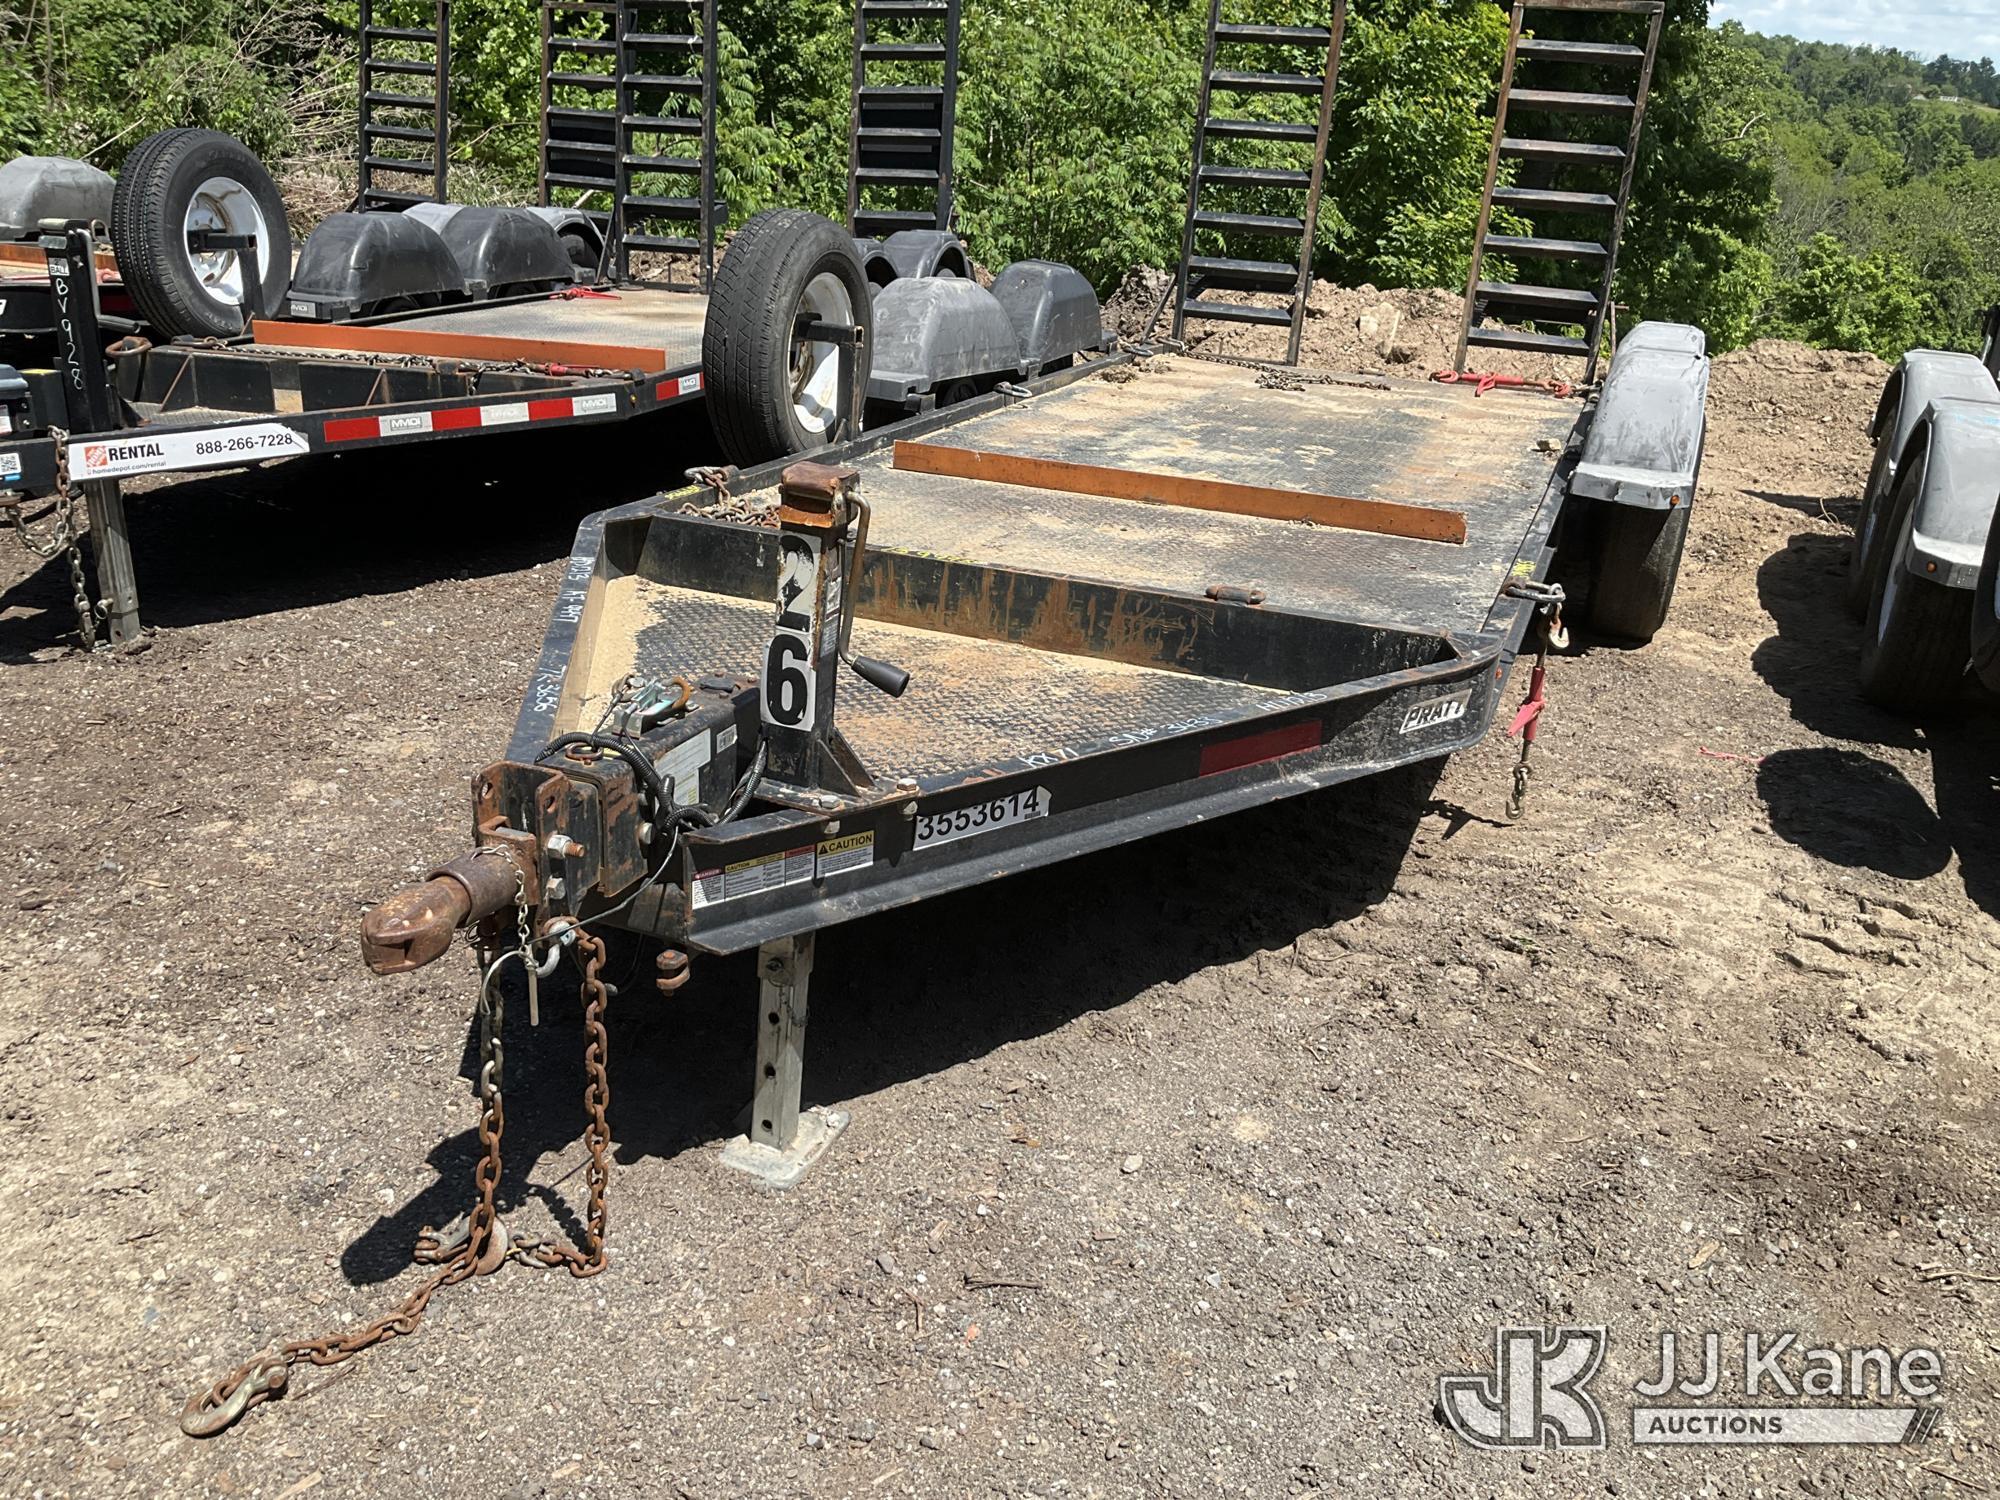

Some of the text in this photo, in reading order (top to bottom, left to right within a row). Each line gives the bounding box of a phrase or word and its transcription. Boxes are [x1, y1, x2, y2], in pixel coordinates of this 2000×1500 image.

[108, 442, 165, 462] RENTAL
[196, 433, 293, 456] 888-266-7228
[92, 461, 167, 475] homedepot.com/rental
[917, 785, 1040, 840] 3553614
[828, 834, 873, 851] CAUTION
